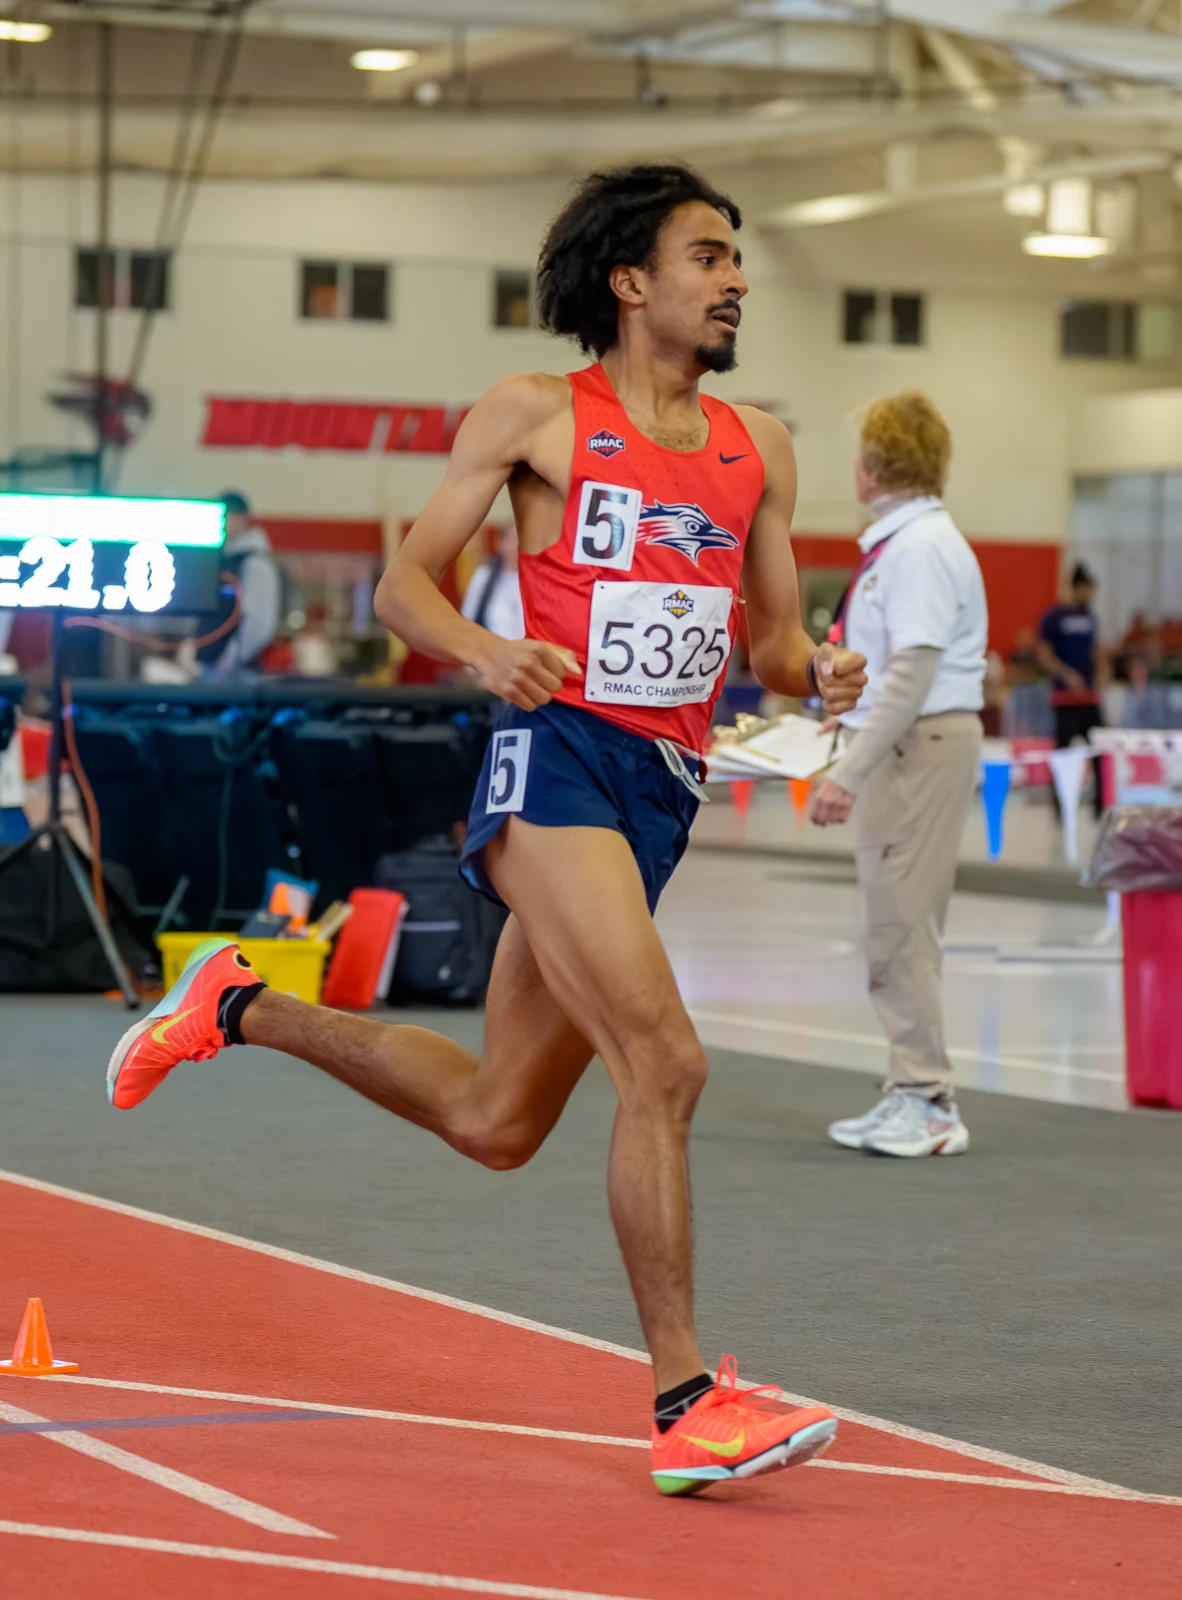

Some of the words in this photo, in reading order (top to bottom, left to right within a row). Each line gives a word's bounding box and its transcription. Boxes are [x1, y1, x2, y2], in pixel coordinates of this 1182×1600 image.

[590, 438, 624, 449] RMAC
[582, 488, 628, 559] 5
[664, 599, 693, 610] RMAC
[598, 621, 726, 679] 5325
[603, 682, 643, 695] RMAC
[491, 736, 518, 806] 5
